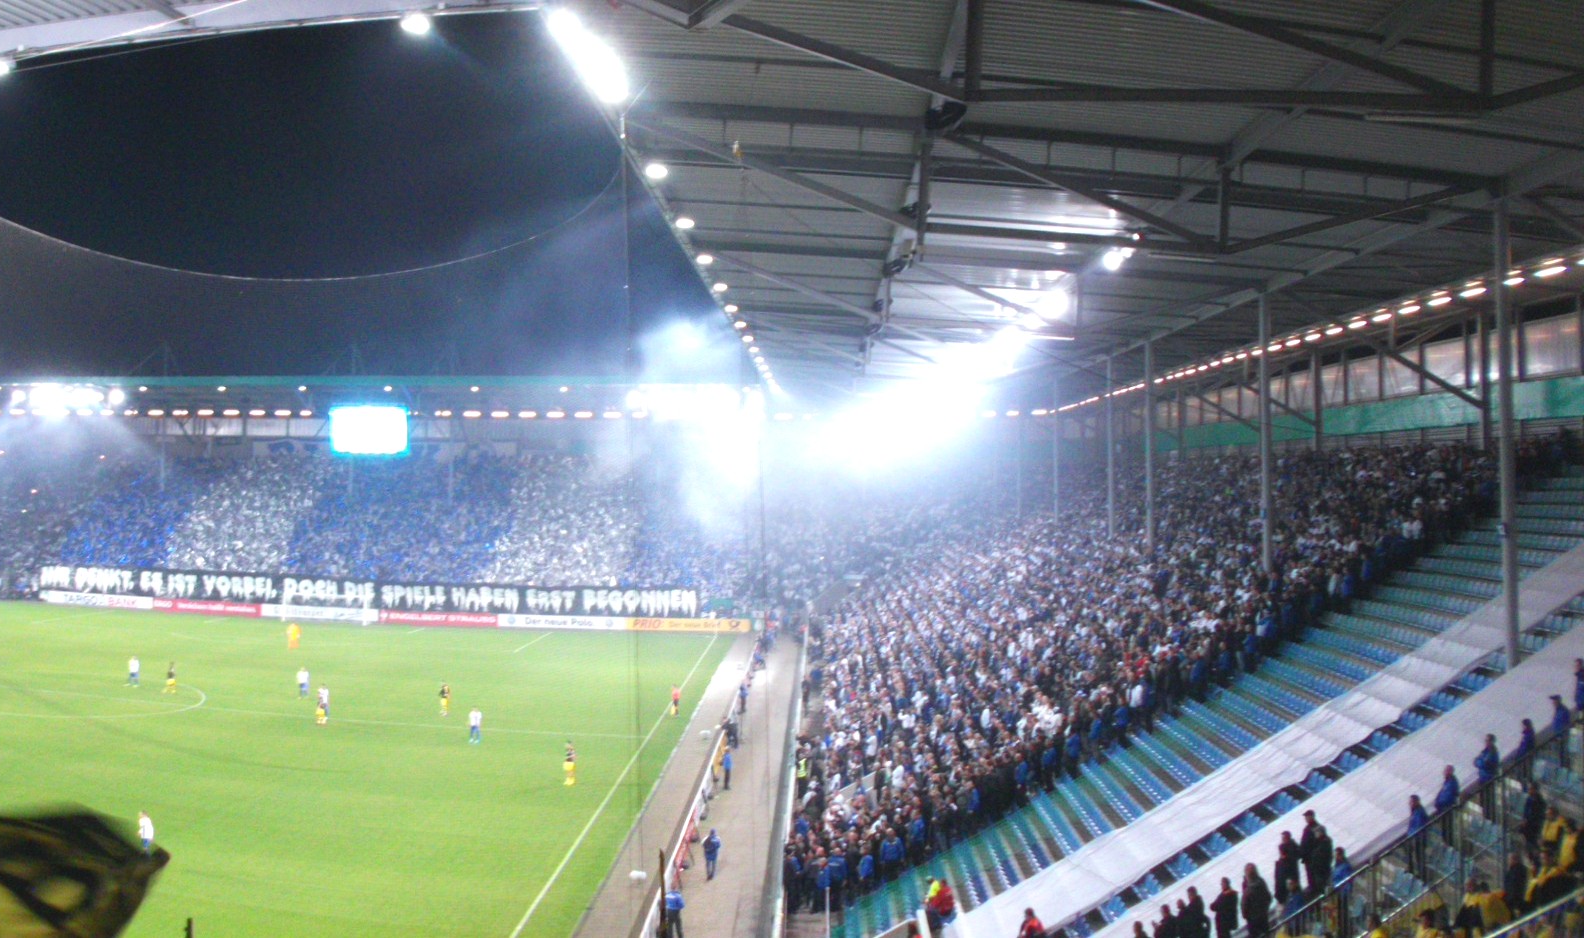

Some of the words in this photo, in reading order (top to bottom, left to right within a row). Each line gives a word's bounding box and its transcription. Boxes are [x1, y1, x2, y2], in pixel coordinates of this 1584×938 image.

[140, 570, 163, 594] ES
[167, 573, 197, 597] IST
[203, 575, 276, 600] VORBEI,
[283, 577, 337, 601] DOCH
[344, 580, 375, 605] DIE
[382, 585, 446, 609] SPIELE
[452, 586, 519, 612] HABEN
[583, 588, 697, 617] BEGONNEN
[390, 611, 446, 621] ENGELBERT
[448, 614, 496, 624] STRAUSS
[525, 617, 542, 626] Der
[544, 619, 569, 627] neue
